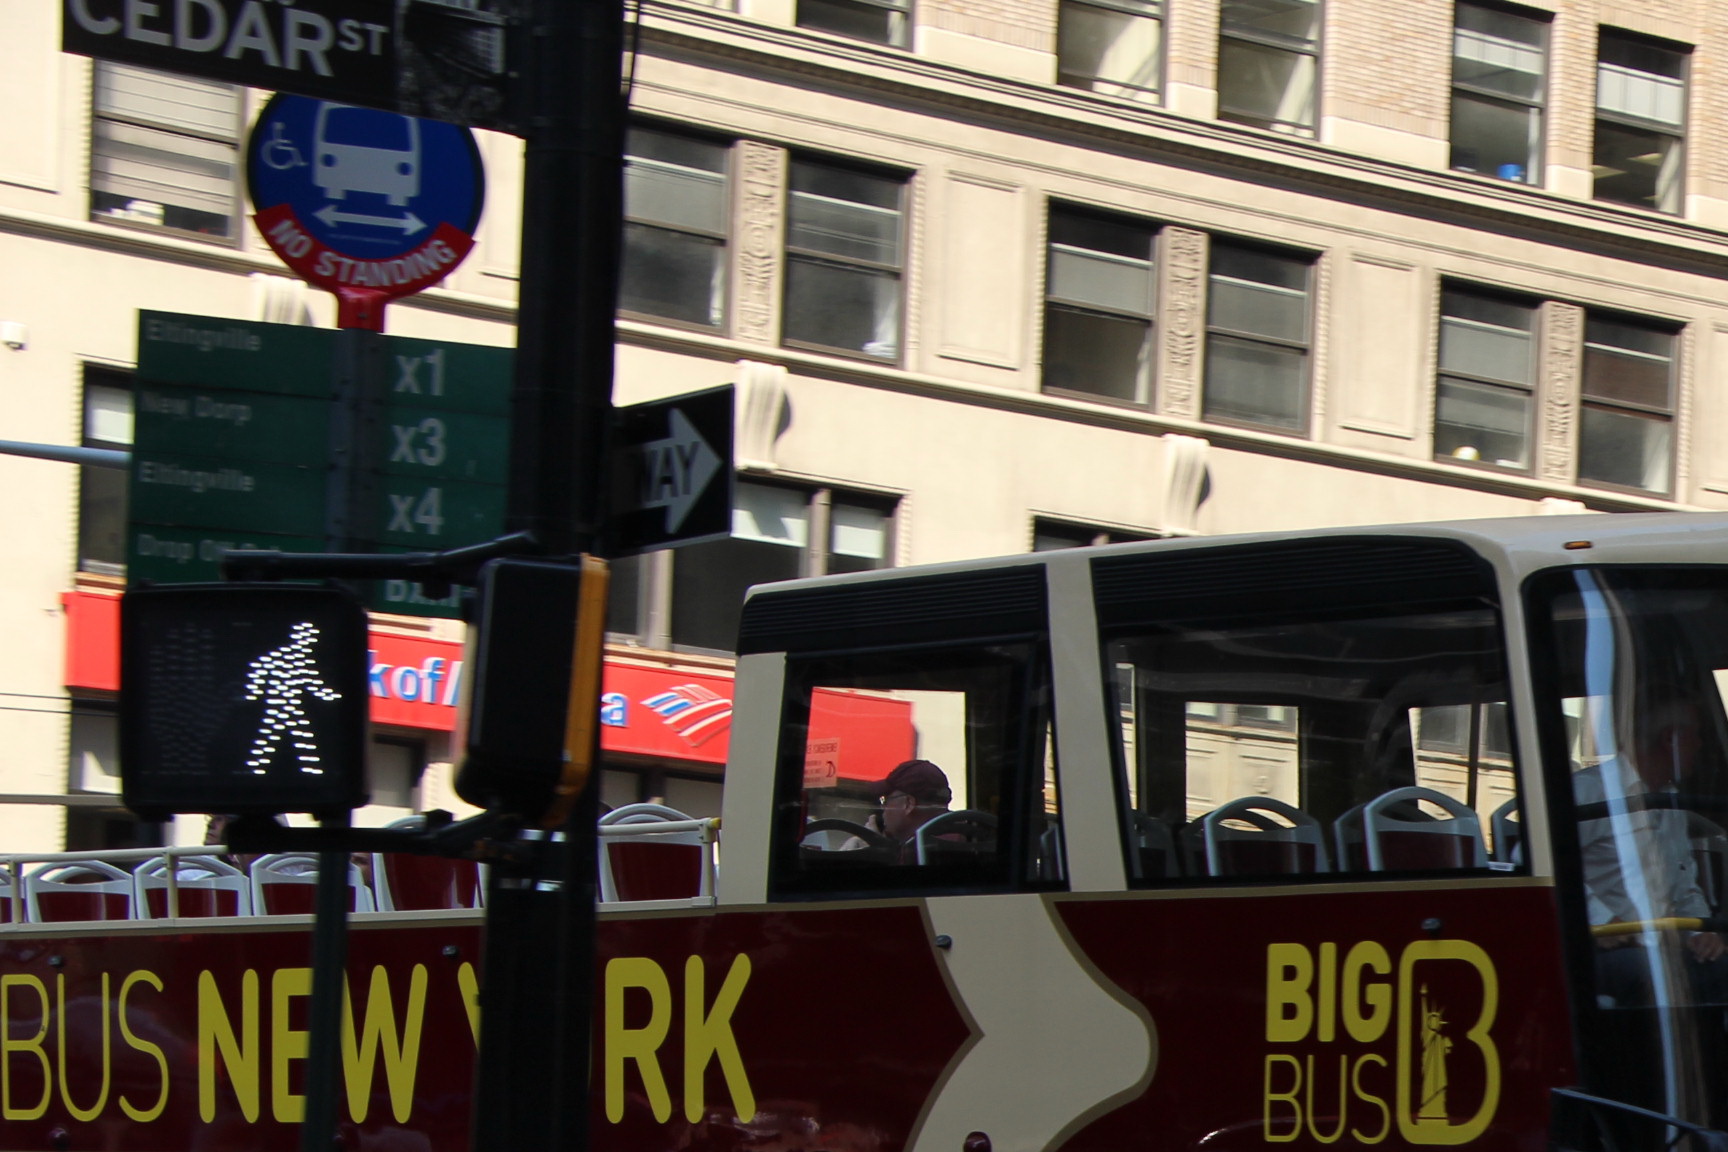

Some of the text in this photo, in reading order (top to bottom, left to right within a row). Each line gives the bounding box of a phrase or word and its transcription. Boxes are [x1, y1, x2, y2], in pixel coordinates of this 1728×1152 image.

[67, 0, 389, 77] CEDAR ST
[267, 219, 457, 288] NO STANDING
[1265, 940, 1393, 1043] BIG
[0, 969, 171, 1122] BUS
[199, 963, 428, 1124] NEW
[1263, 1053, 1392, 1145] BUS
